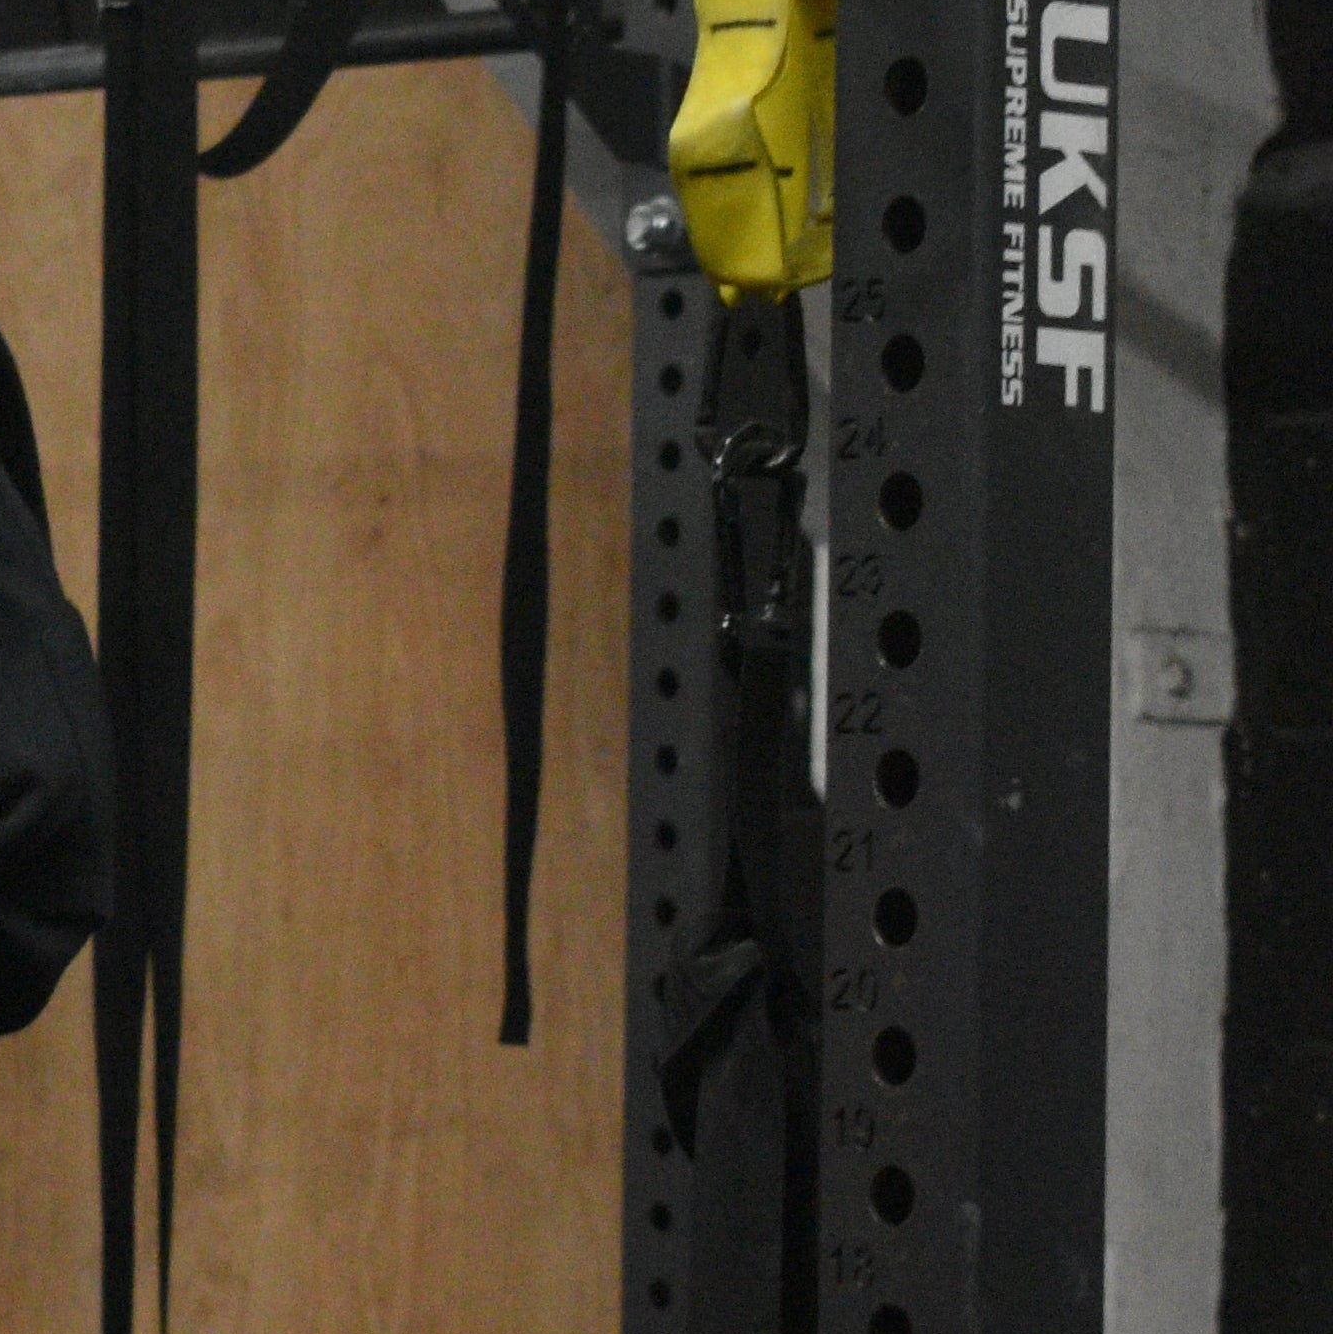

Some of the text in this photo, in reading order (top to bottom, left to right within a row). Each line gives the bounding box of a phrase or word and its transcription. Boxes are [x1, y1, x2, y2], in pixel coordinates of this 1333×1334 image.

[1037, 0, 1110, 413] UKSF
[1001, 222, 1026, 407] FITNESS
[834, 691, 885, 736] 22
[831, 829, 875, 874] 21
